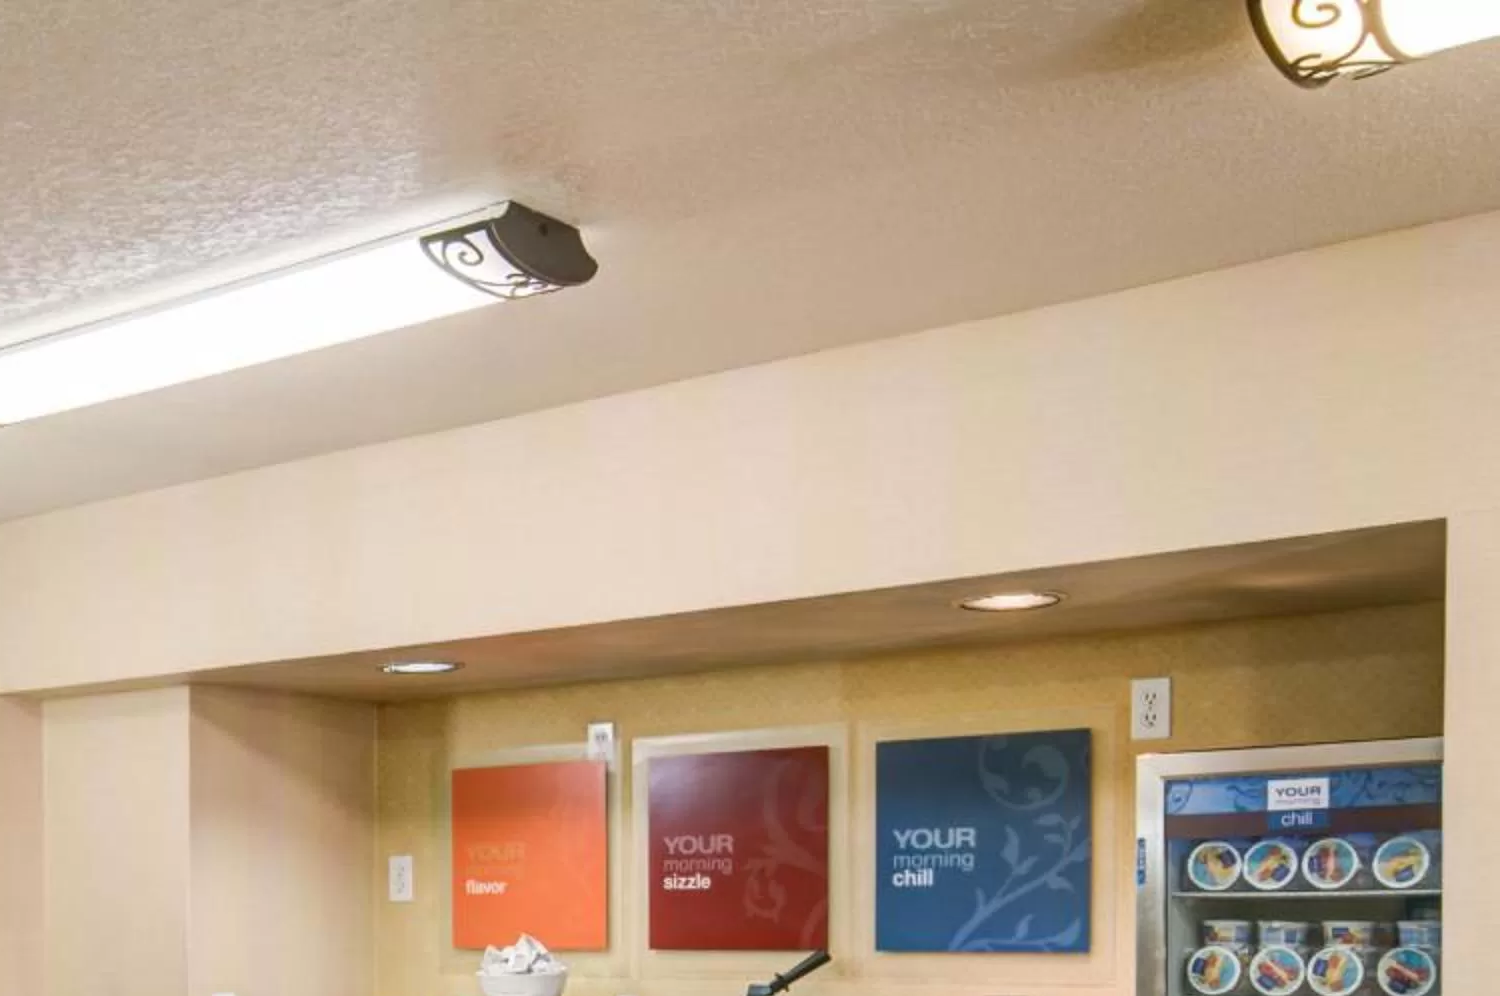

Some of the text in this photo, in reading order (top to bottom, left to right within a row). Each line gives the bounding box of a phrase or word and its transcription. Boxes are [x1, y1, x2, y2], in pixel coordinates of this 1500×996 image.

[1274, 785, 1322, 797] YOUR
[1281, 810, 1313, 827] chill
[663, 833, 734, 855] YOUR
[892, 826, 977, 849] YOUR
[663, 857, 733, 875] morning
[893, 851, 975, 872] morning
[465, 879, 509, 895] flavor
[662, 872, 712, 890] sizzle
[892, 868, 934, 888] chill
